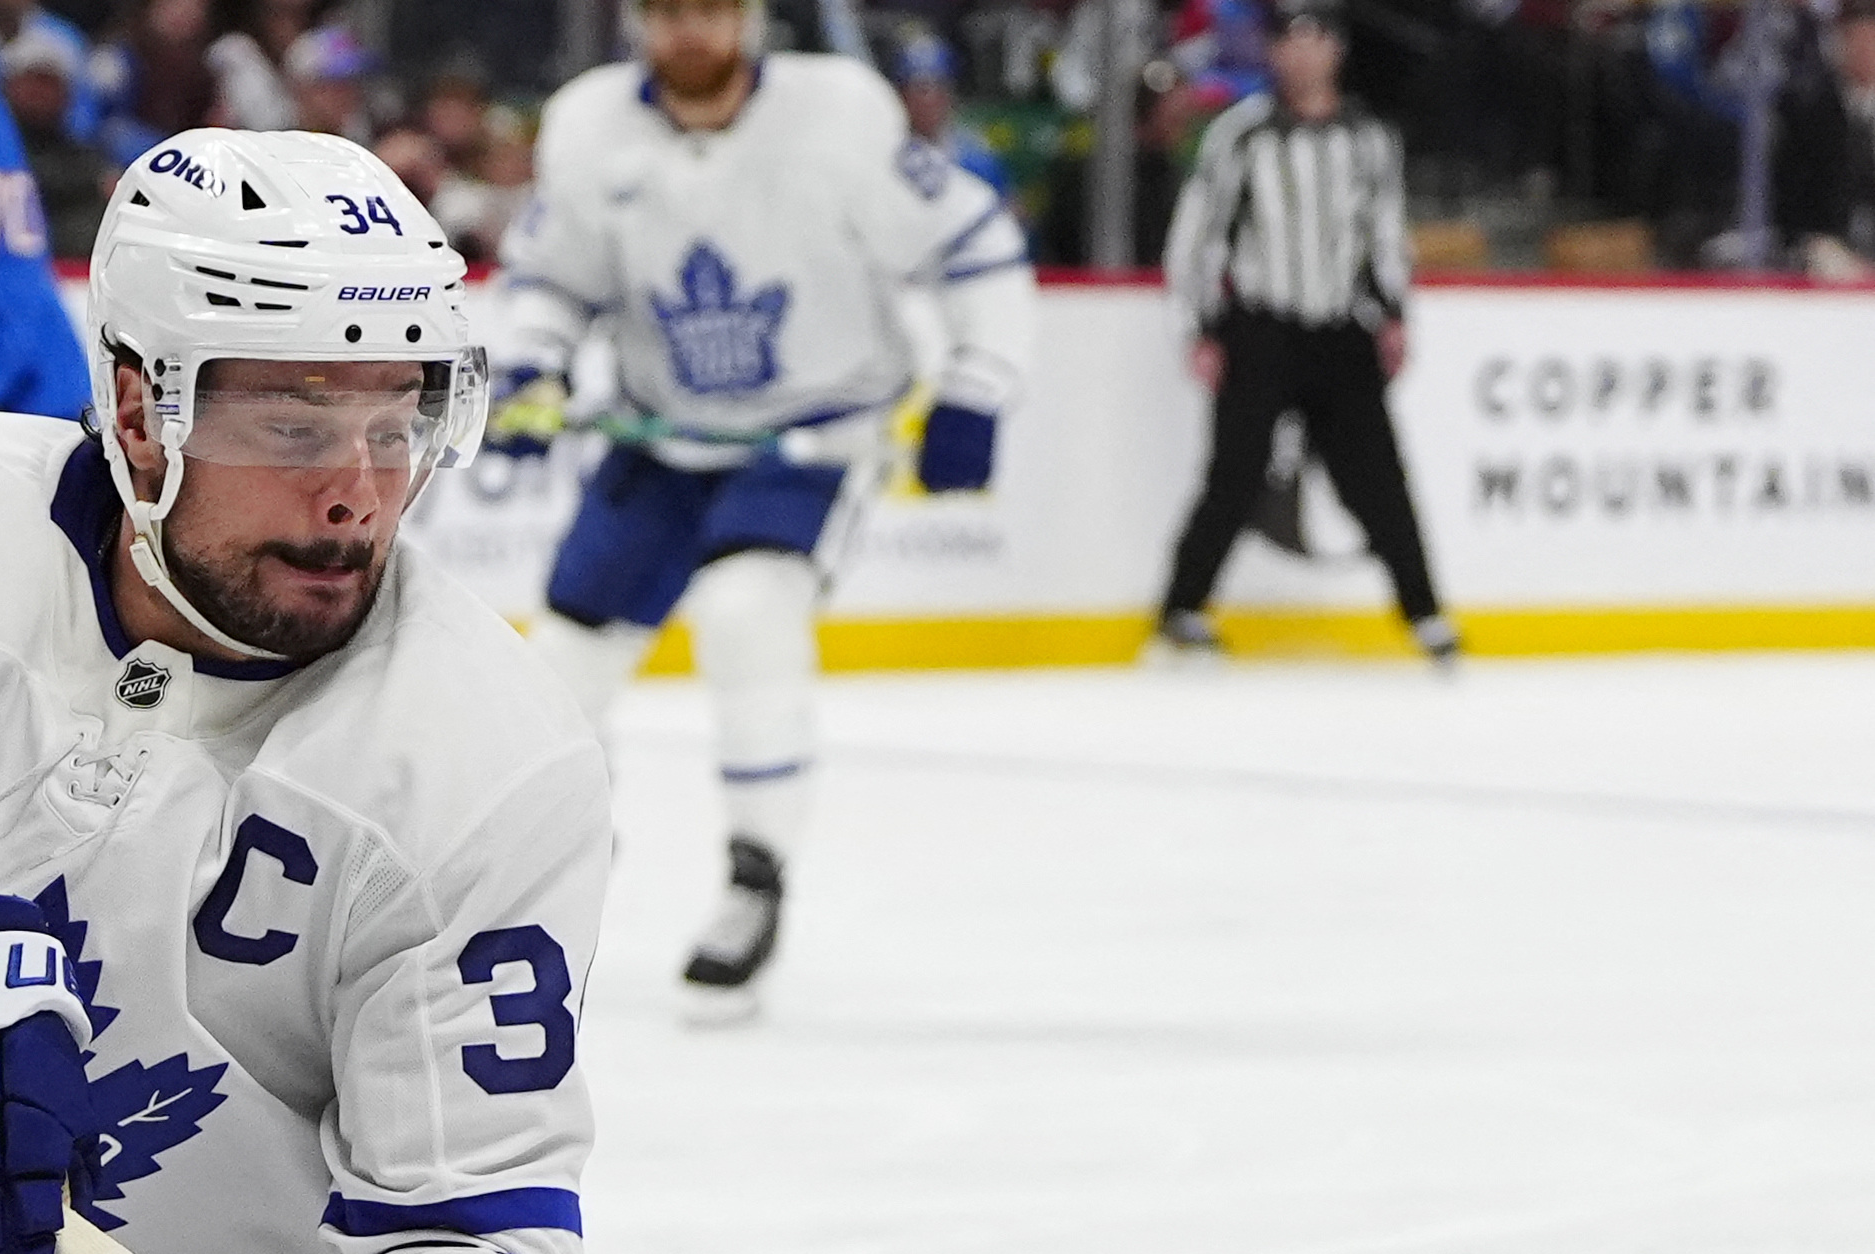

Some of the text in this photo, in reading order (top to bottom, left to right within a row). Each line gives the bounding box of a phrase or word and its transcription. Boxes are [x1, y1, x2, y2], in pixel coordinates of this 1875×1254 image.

[325, 194, 404, 237] 34
[338, 285, 432, 301] BAUER
[1473, 354, 1779, 420] COPPER
[193, 813, 319, 966] C
[457, 923, 592, 1095] 3
